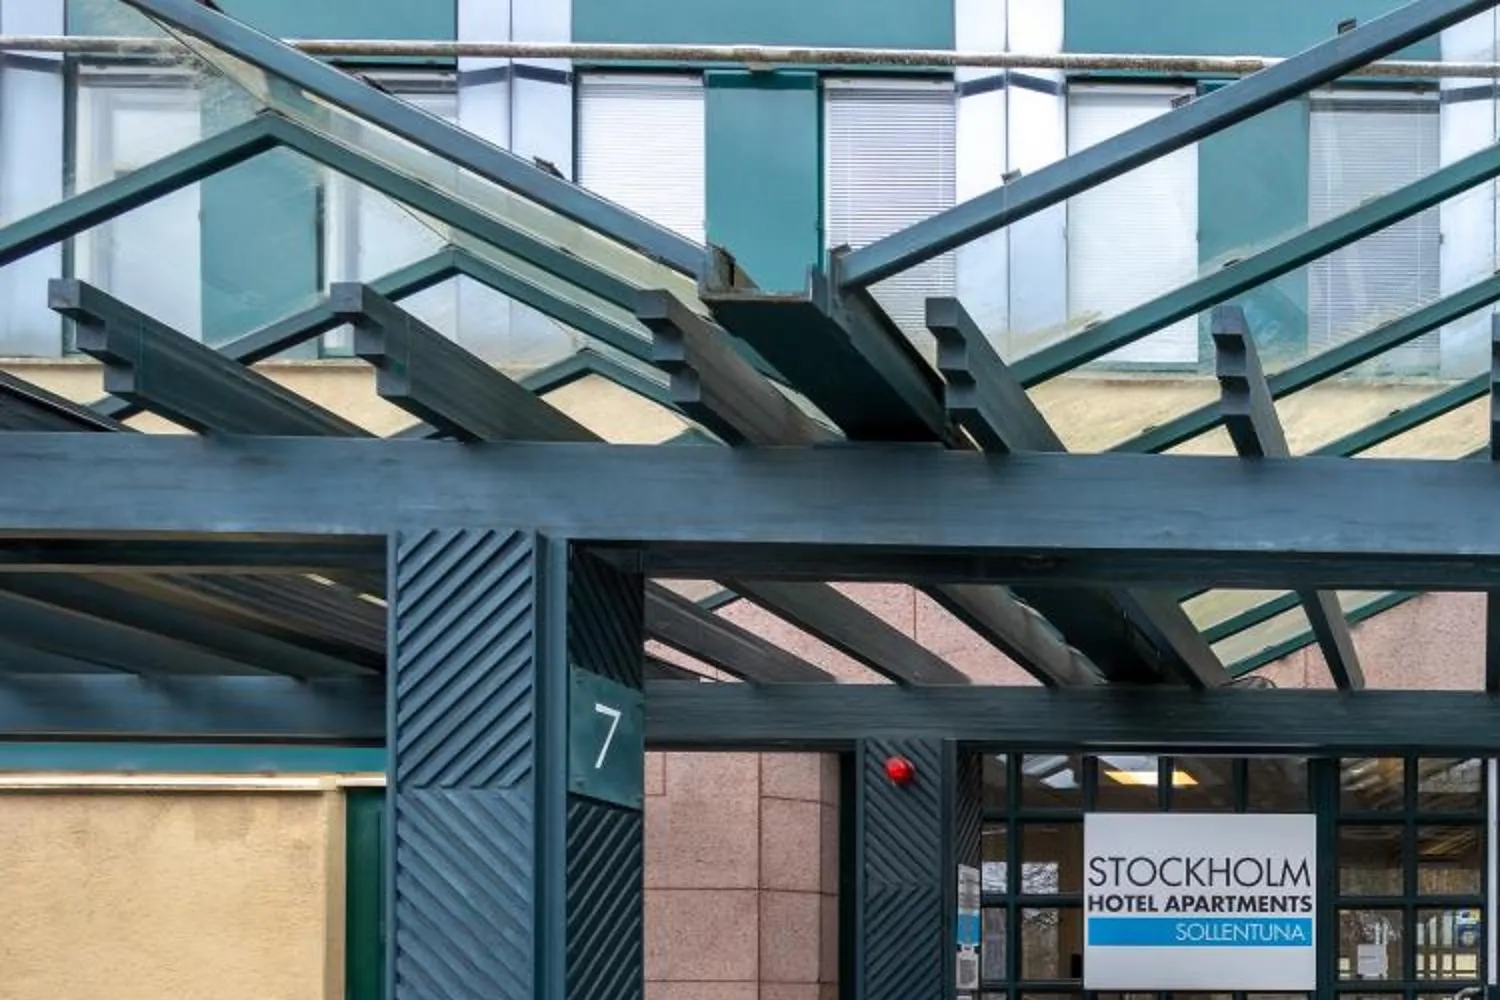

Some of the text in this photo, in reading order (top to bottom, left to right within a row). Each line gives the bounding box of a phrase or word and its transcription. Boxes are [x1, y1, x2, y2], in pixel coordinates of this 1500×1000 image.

[594, 702, 622, 769] 7
[1087, 856, 1312, 888] STOCKHOLM
[1087, 894, 1313, 913] HOTEL APARTMENTS
[1175, 923, 1306, 941] SOLLENTUNA
